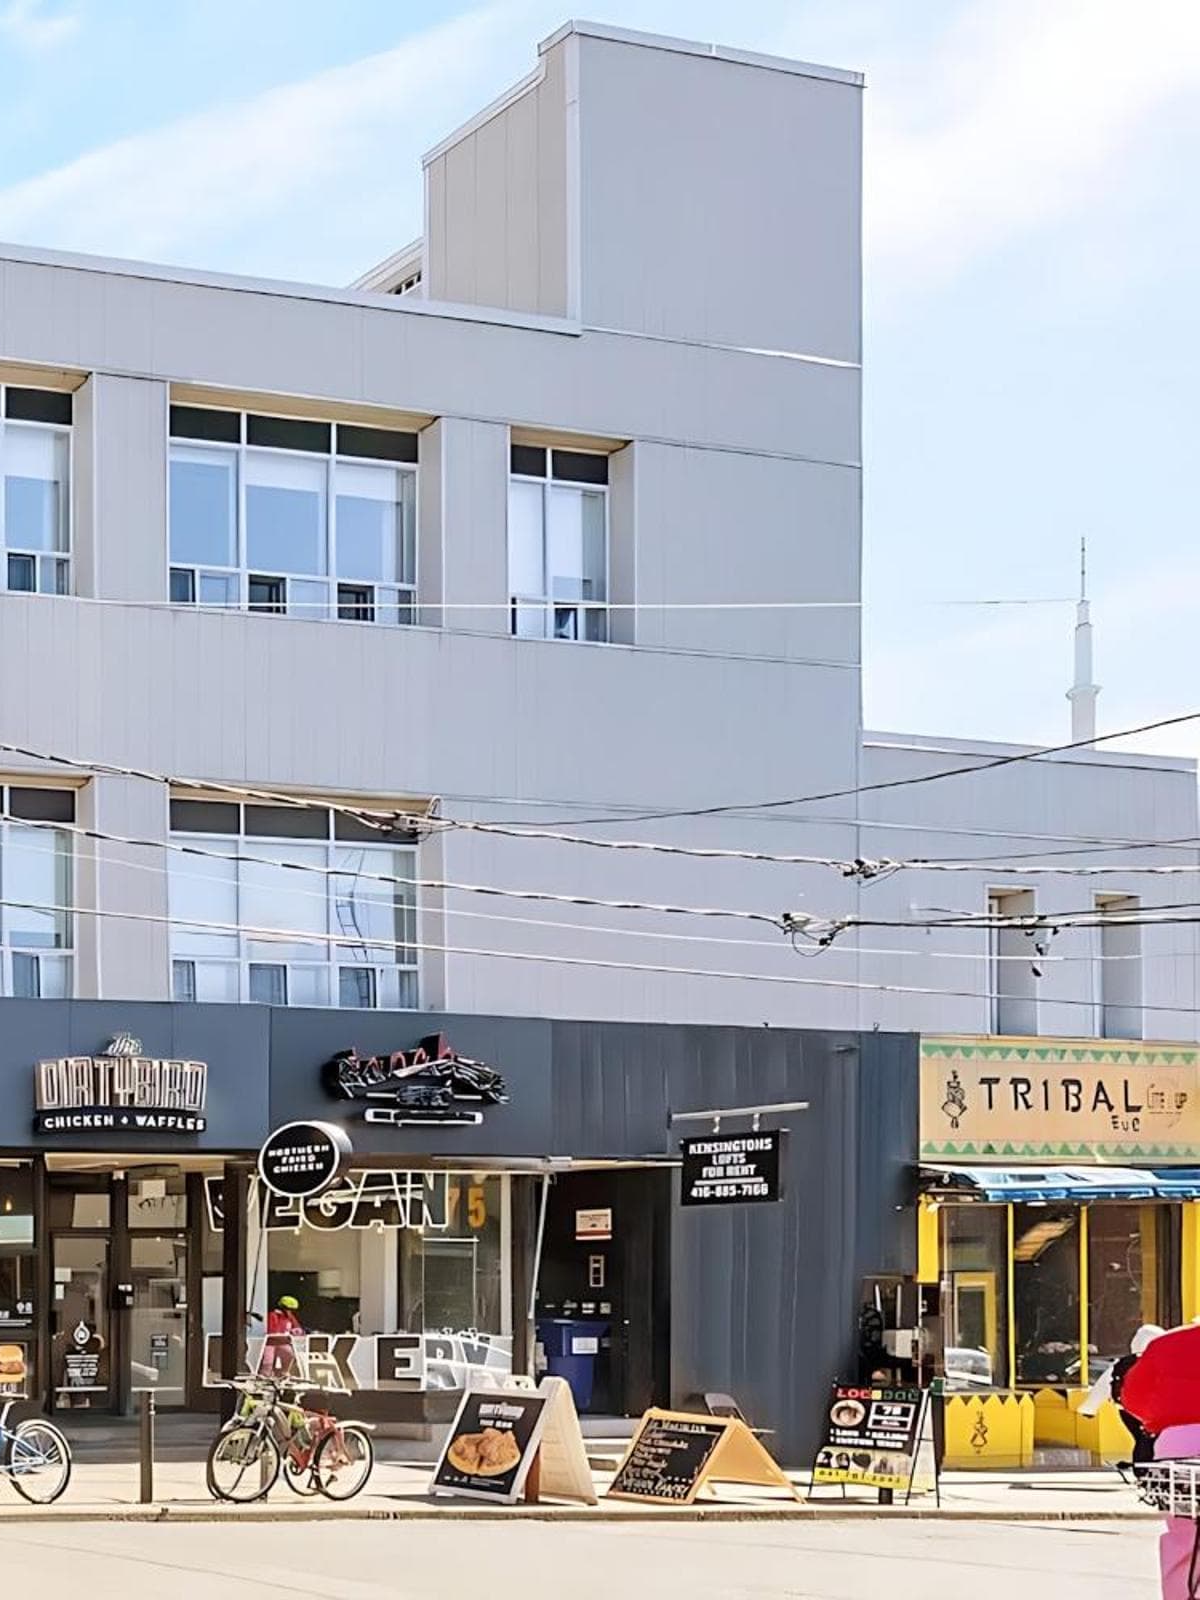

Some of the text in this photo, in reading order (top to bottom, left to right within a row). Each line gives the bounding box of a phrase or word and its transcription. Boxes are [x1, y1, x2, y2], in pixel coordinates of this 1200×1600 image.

[36, 1057, 208, 1112] DIRTYBIRD
[978, 1077, 1142, 1113] TRIBAL
[44, 1115, 115, 1129] CHICKEN
[135, 1115, 206, 1131] WAFFLES
